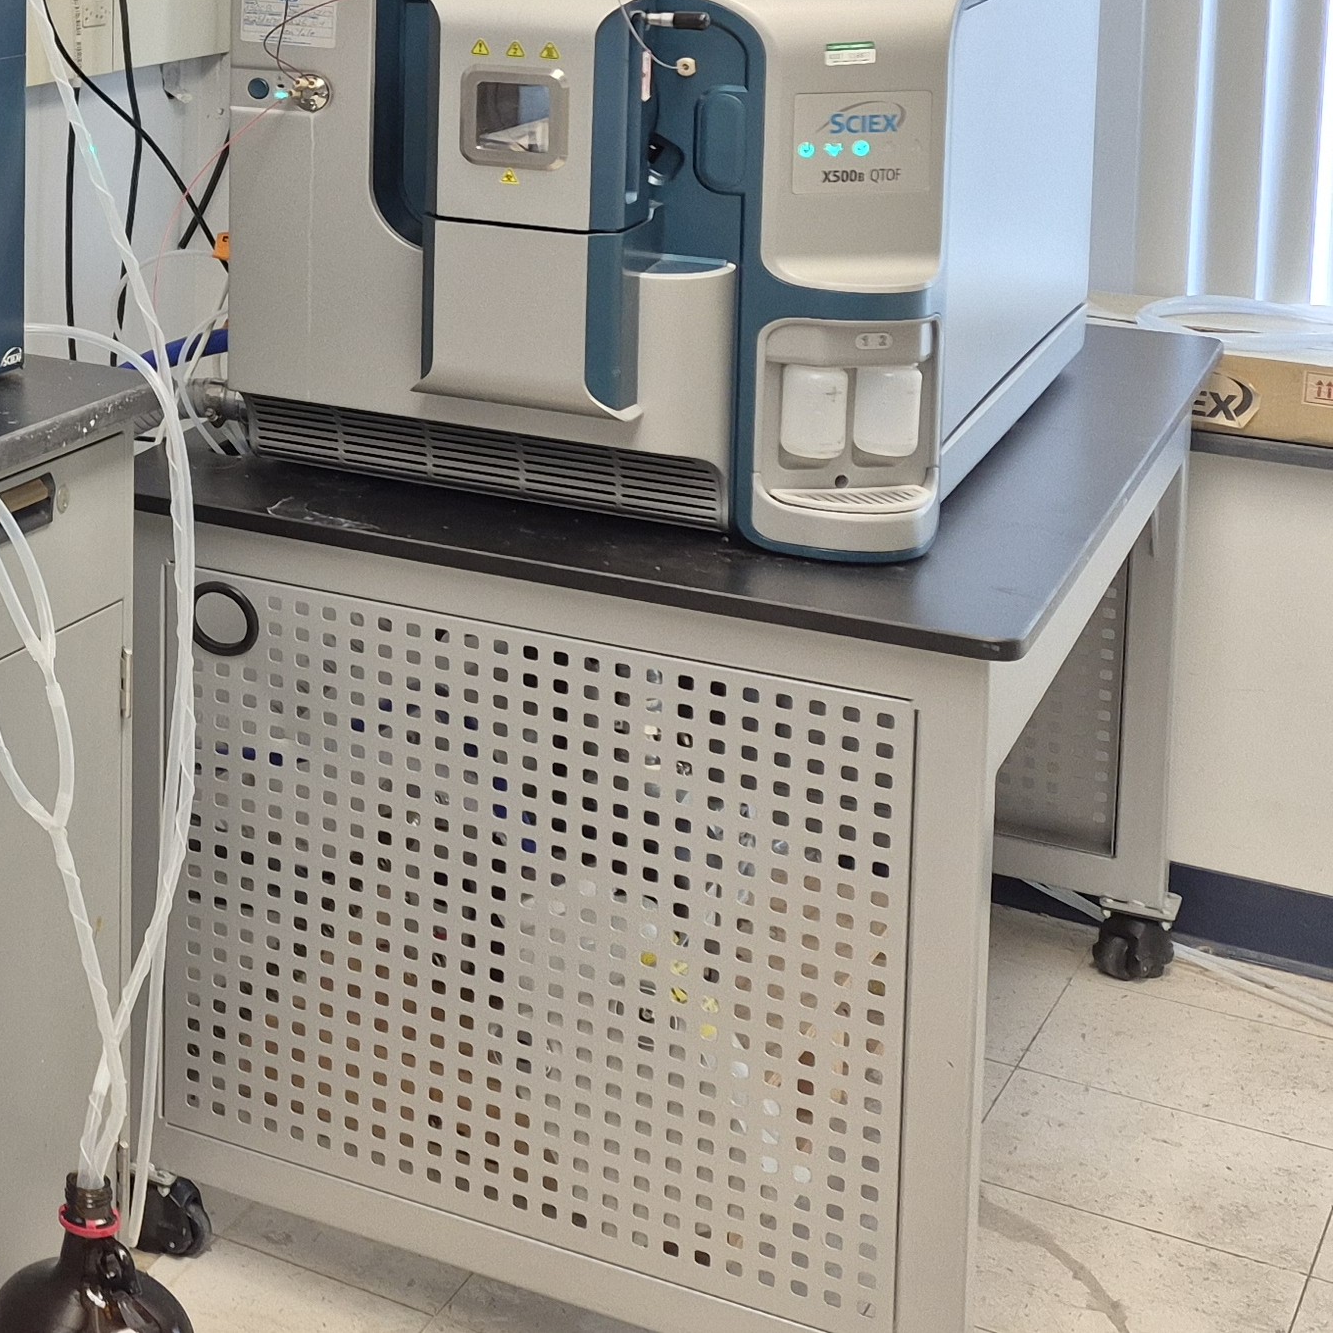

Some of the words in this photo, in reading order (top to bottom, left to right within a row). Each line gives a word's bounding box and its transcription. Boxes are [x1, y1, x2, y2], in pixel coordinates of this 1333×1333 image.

[829, 114, 898, 134] SCIEX
[822, 169, 865, 183] X500B
[870, 168, 902, 183] QTOF
